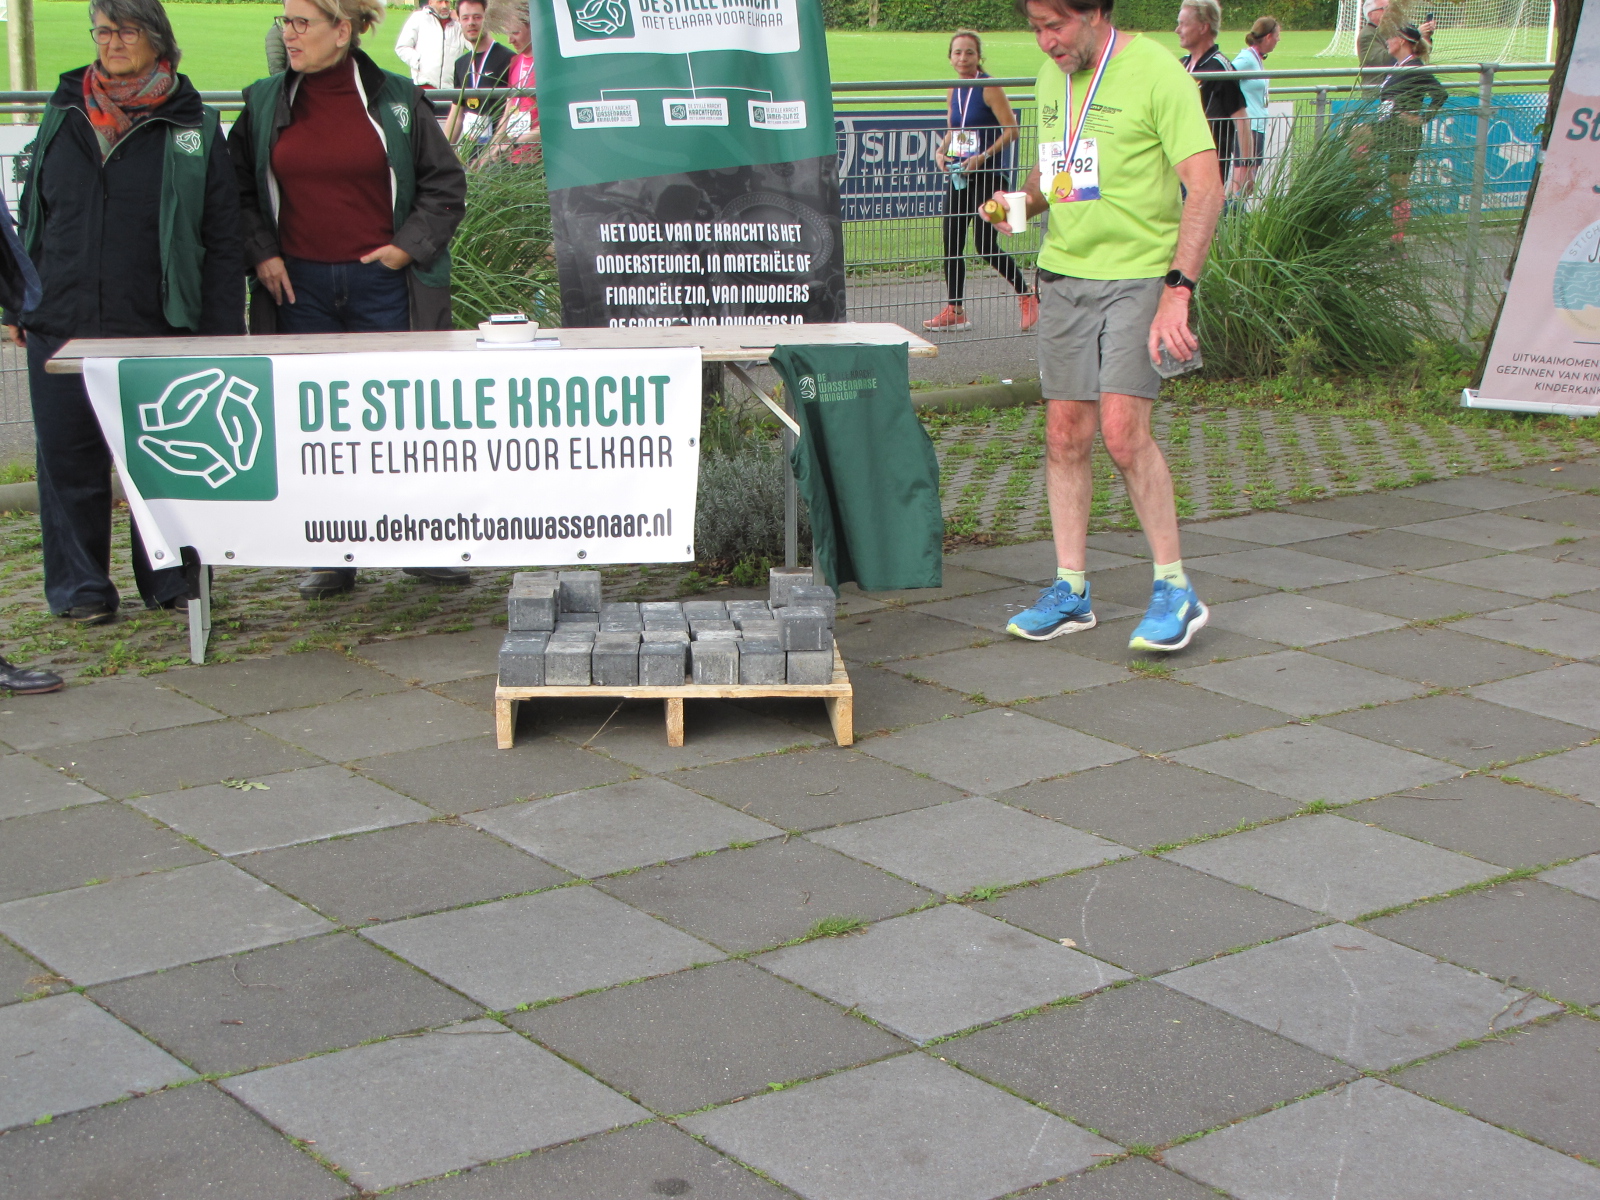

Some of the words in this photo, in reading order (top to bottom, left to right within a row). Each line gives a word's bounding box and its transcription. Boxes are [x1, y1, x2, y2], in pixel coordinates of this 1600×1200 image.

[642, 15, 665, 30] MET
[669, 12, 713, 30] ELKAAR
[715, 10, 746, 26] VOOR
[747, 11, 783, 27] ELKAAR
[1051, 157, 1093, 176] 1592
[600, 223, 626, 242] HET
[629, 223, 663, 242] DOEL
[665, 223, 693, 242] VAN
[696, 223, 712, 242] DE
[714, 223, 764, 242] KRACHT
[767, 223, 780, 242] IS
[781, 224, 802, 243] HET
[596, 254, 705, 275] ONDERSTEUNEN,
[707, 254, 721, 272] IN
[723, 250, 795, 273] MATERIËLE
[797, 254, 811, 272] OF
[606, 282, 682, 305] FINANCIËLE
[684, 285, 710, 306] ZIN,
[712, 285, 740, 304] VAN
[742, 284, 809, 304] INWONERS
[817, 373, 827, 382] DE
[1496, 365, 1555, 378] GEZINNEN
[1558, 371, 1580, 380] VAN
[818, 378, 878, 394] WASSENAARSE
[299, 379, 352, 432] DE
[361, 377, 497, 431] STILLE
[509, 375, 671, 428] KRACHT
[819, 391, 857, 402] KRINGLOOP
[301, 441, 361, 475] MET
[371, 440, 477, 474] ELKAAR
[487, 438, 559, 471] VOOR
[569, 435, 673, 470] ELKAAR
[304, 508, 673, 543] www.dekrachtvanwassenaar.nl
